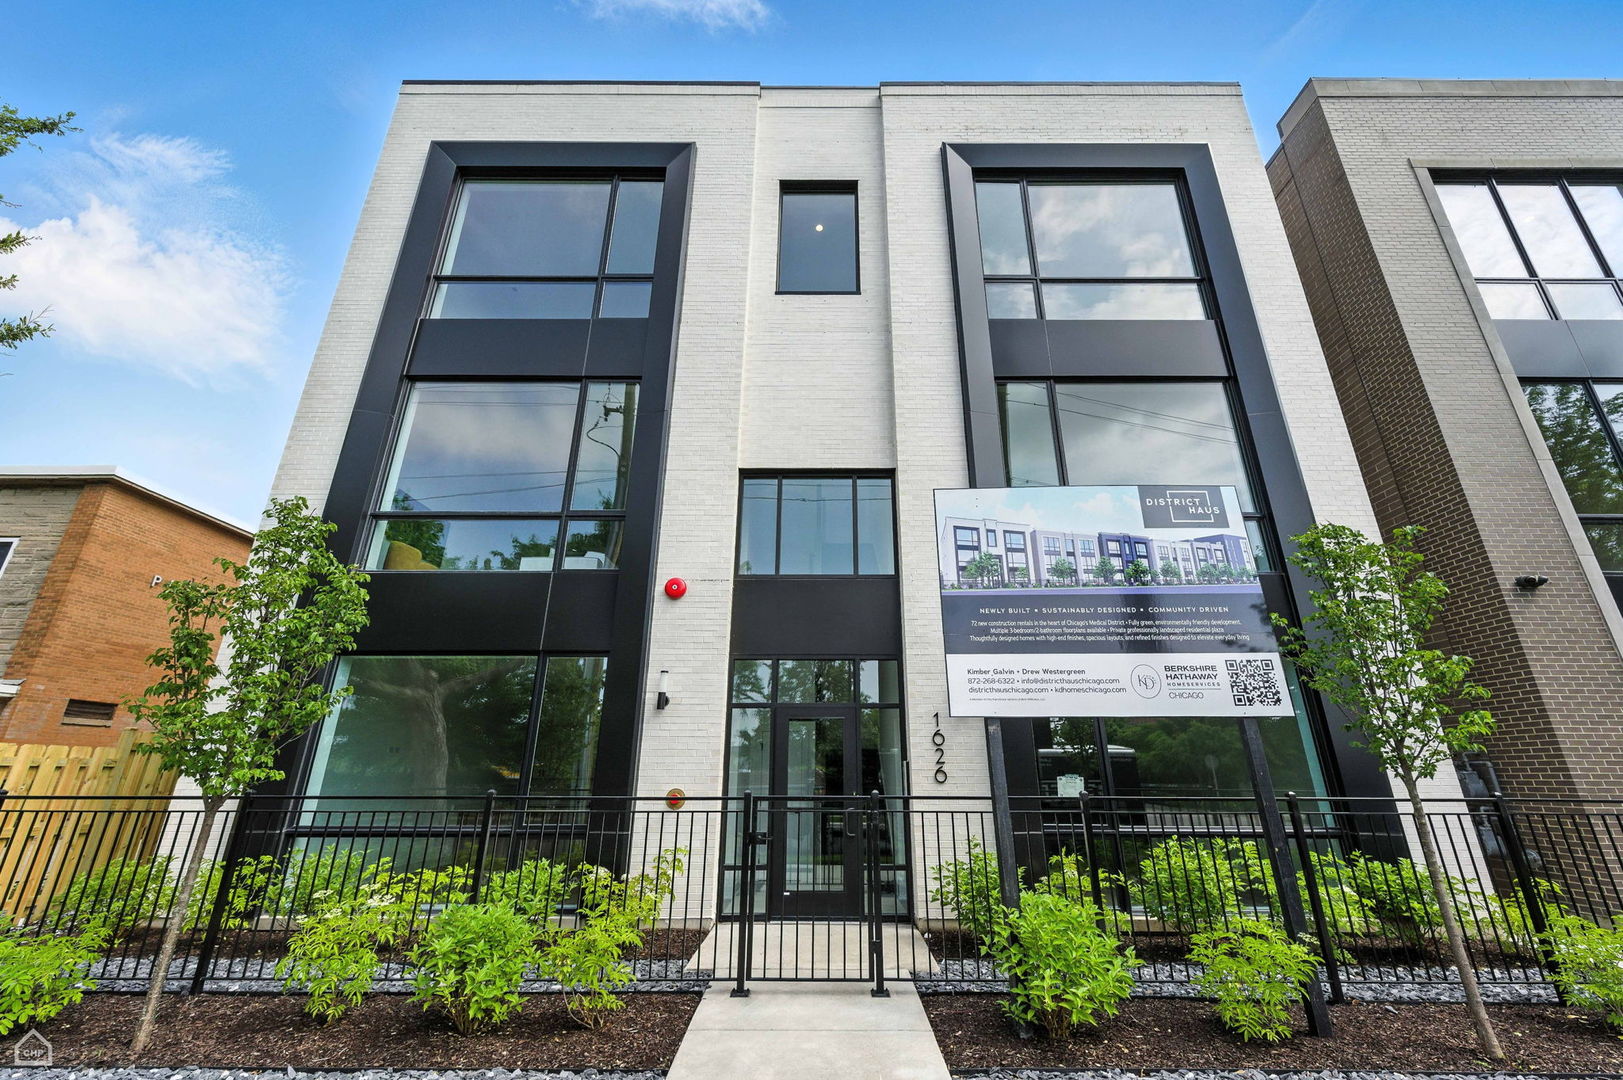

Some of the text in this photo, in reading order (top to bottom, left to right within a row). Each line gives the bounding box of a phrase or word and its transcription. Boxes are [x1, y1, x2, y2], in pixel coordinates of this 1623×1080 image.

[1146, 498, 1200, 506] DISTRICT
[1189, 506, 1220, 514] HAUS
[1128, 619, 1140, 627] Fully
[1155, 619, 1192, 627] environmentally
[1192, 619, 1210, 627] friendly
[1127, 626, 1159, 634] professionally
[1160, 626, 1185, 634] landscaped
[1169, 634, 1191, 642] designed
[1042, 668, 1086, 676] Westergreen
[1021, 677, 1120, 685] info@districthauschicago.com
[968, 686, 1127, 694] districthauschicago.com kdhomeschicago.com
[1168, 691, 1204, 699] CHICAGO
[932, 711, 948, 784] 1626
